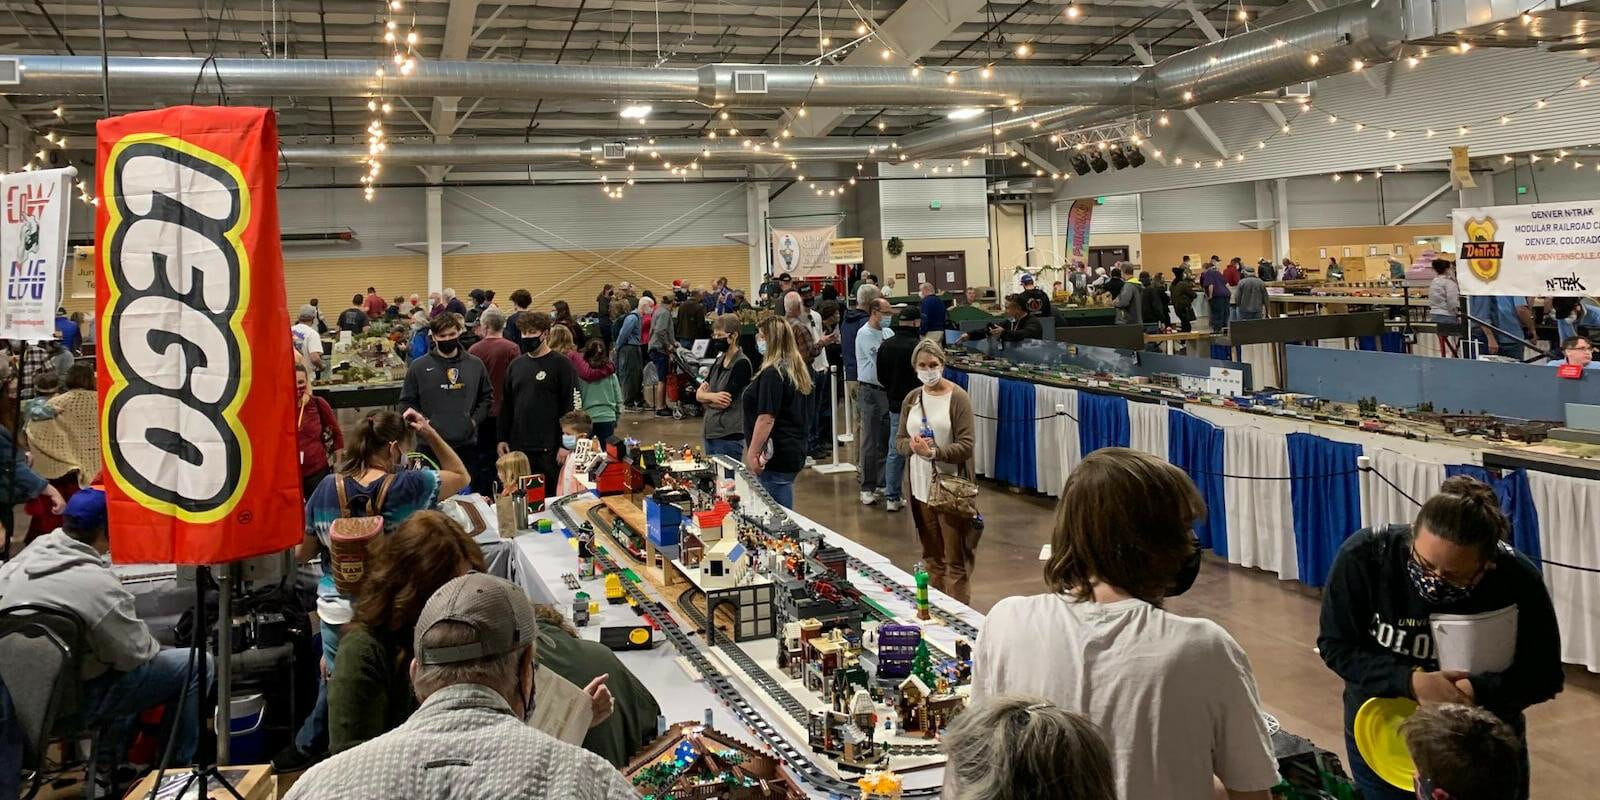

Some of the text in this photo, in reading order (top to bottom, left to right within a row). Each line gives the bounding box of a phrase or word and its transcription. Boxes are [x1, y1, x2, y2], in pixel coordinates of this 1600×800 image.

[1531, 207, 1594, 219] DENVER N-TRAK
[1515, 221, 1600, 233] MODULAR RAILROAD C
[113, 152, 235, 502] LEGO
